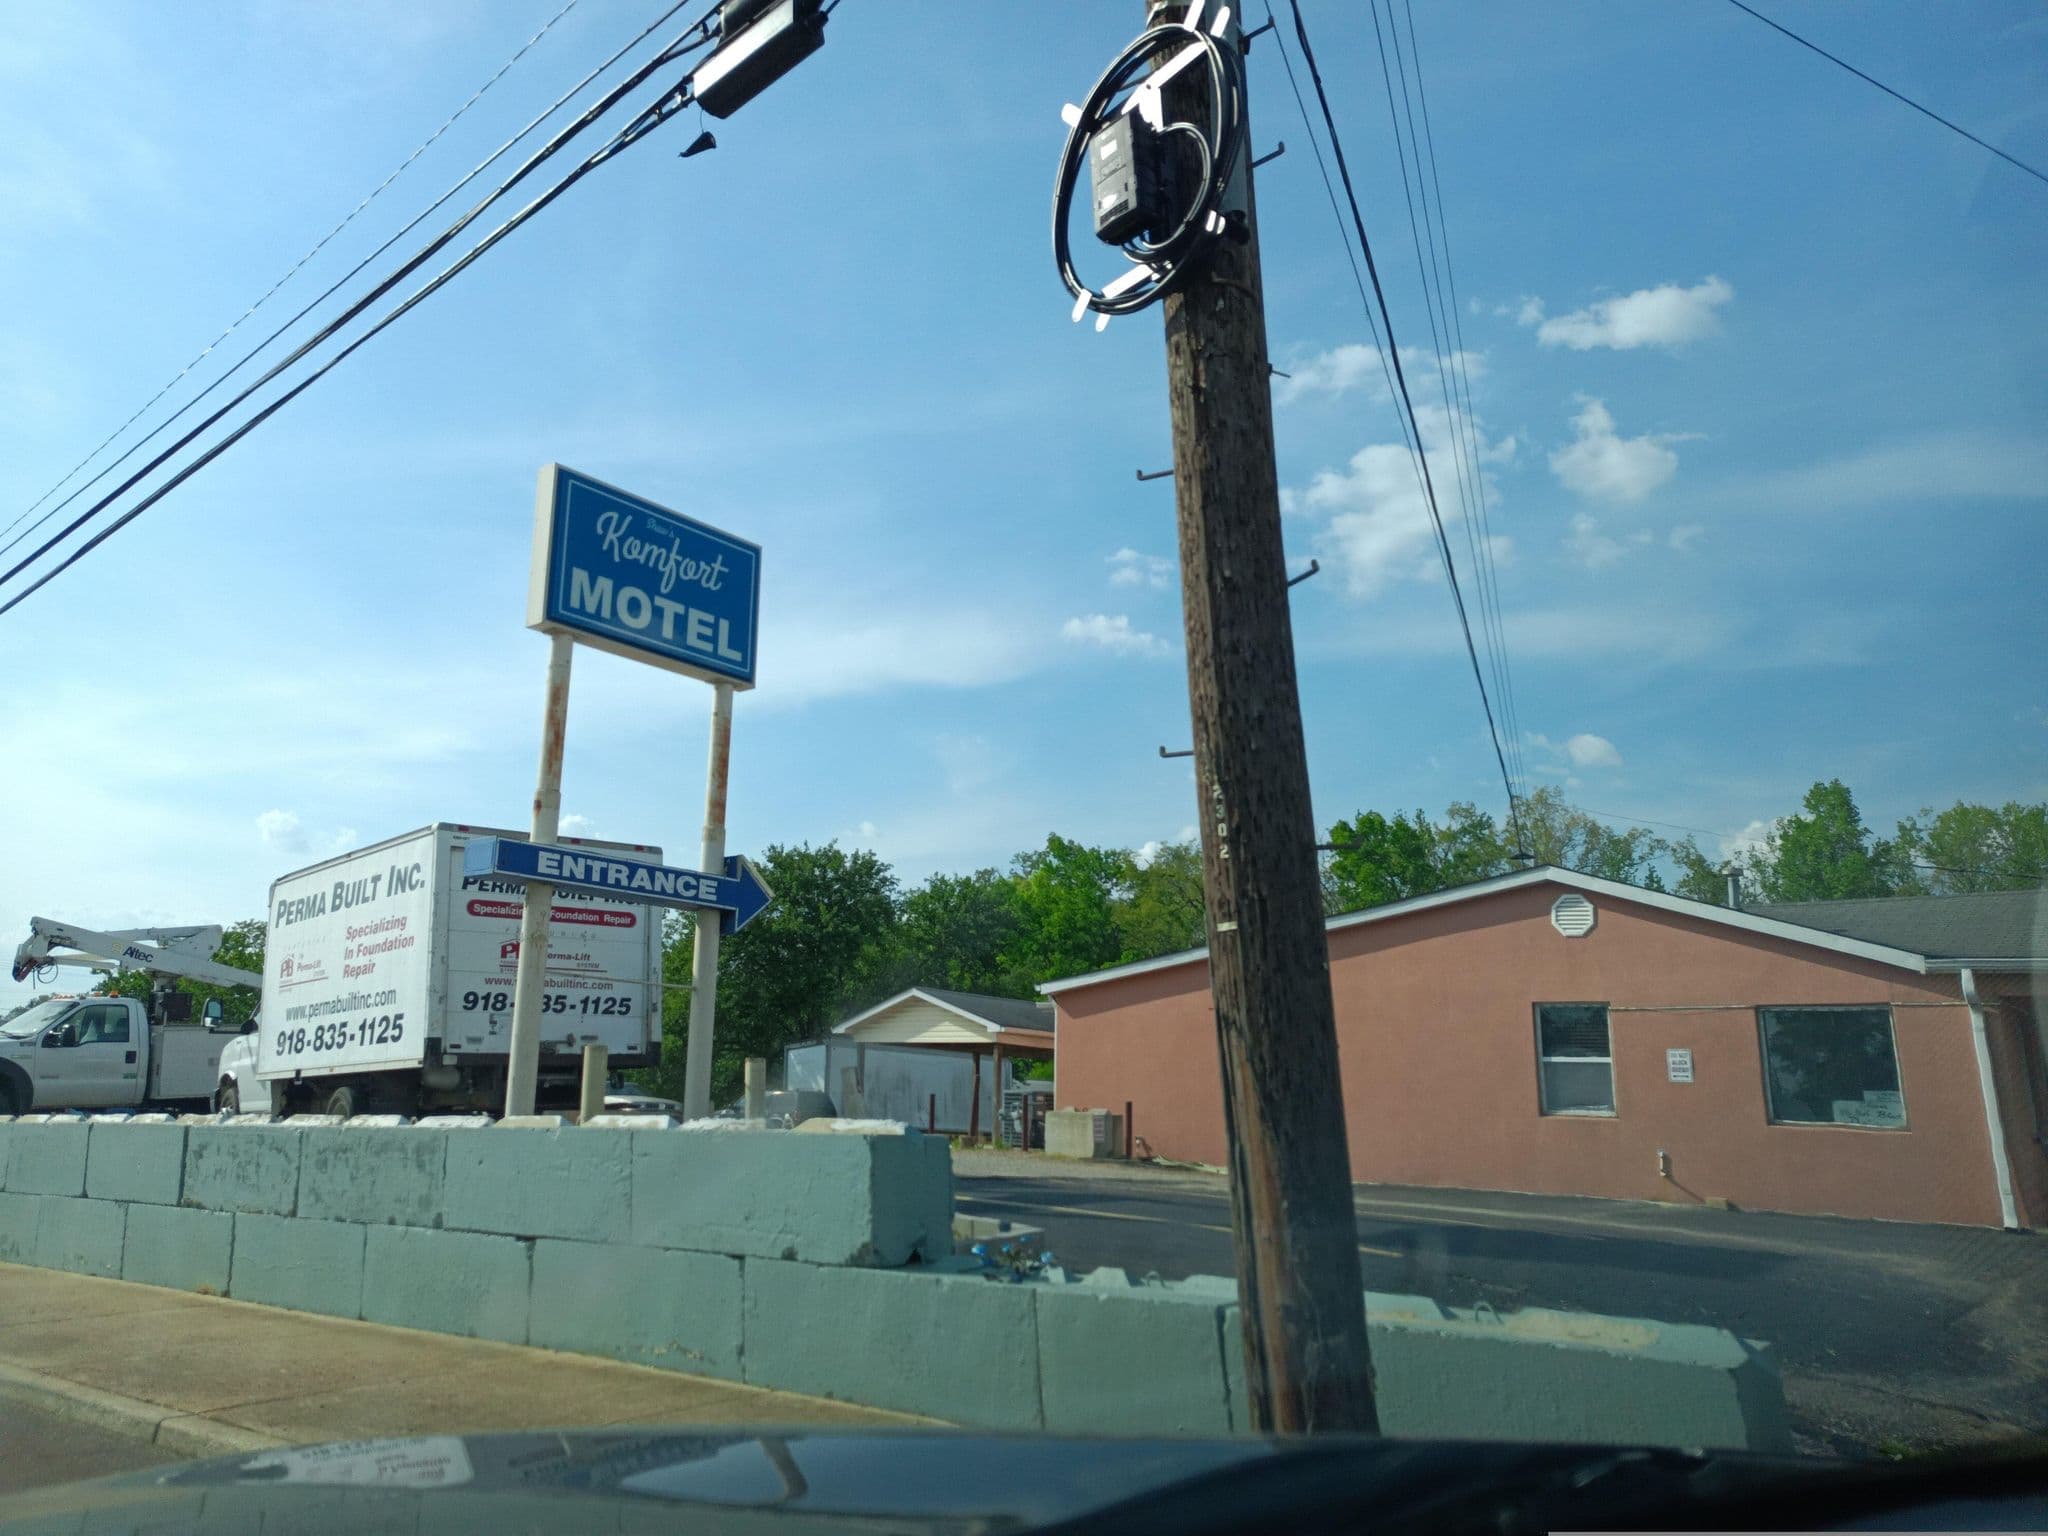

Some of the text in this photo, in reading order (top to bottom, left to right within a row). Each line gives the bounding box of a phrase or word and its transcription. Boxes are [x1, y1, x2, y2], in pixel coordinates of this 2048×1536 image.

[597, 512, 729, 594] Komfort
[570, 567, 742, 661] MOTEL
[537, 851, 718, 901] ENTRANCE
[275, 863, 425, 928] PERMA BUILT INC.
[473, 903, 523, 917] Specializin
[551, 911, 632, 925] Foundation Repair
[346, 915, 408, 941] Specializing
[122, 946, 154, 963] Altec
[344, 934, 414, 960] In Foundation
[343, 960, 376, 979] Repair
[286, 989, 397, 1023] www.permabuiltinc.com
[463, 991, 632, 1017] 918-35-1125
[276, 1013, 404, 1056] 918-835-1125
